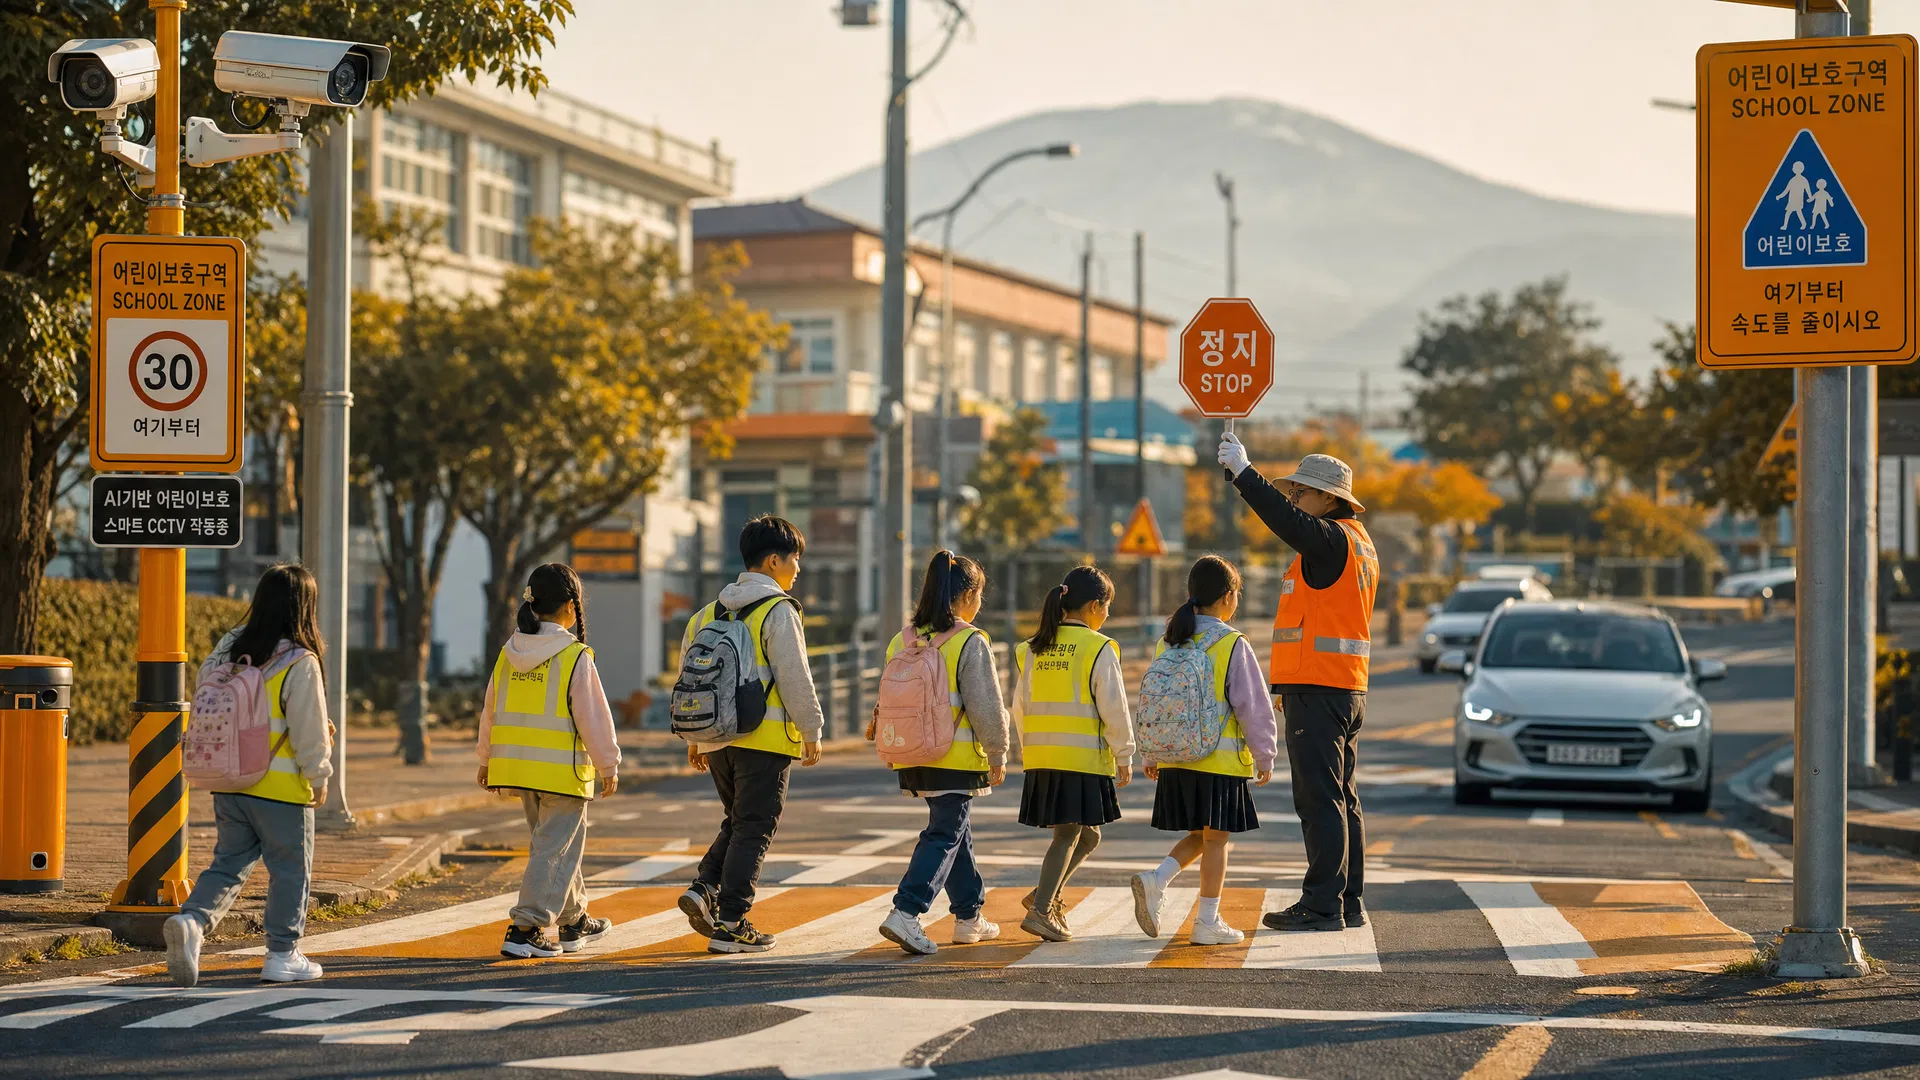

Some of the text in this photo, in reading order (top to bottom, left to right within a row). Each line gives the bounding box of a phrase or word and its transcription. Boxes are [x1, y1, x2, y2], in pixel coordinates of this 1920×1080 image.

[1728, 59, 1887, 92] 어린이보호구역
[1731, 93, 1886, 118] SCHOOL ZONE
[1757, 233, 1852, 256] 어린이보호
[113, 261, 227, 288] 어린이보호구역
[113, 292, 226, 311] SCHOOL ZONE
[1764, 280, 1843, 305] 여기부터
[1731, 310, 1881, 336] 속도를 줄이시오
[1198, 329, 1257, 367] 정지
[143, 353, 193, 391] 30
[1200, 373, 1253, 393] STOP
[133, 417, 201, 438] 여기부터
[103, 489, 231, 509] AI기반 어린이보호
[103, 517, 144, 535] 스마트
[147, 518, 186, 534] CCTV
